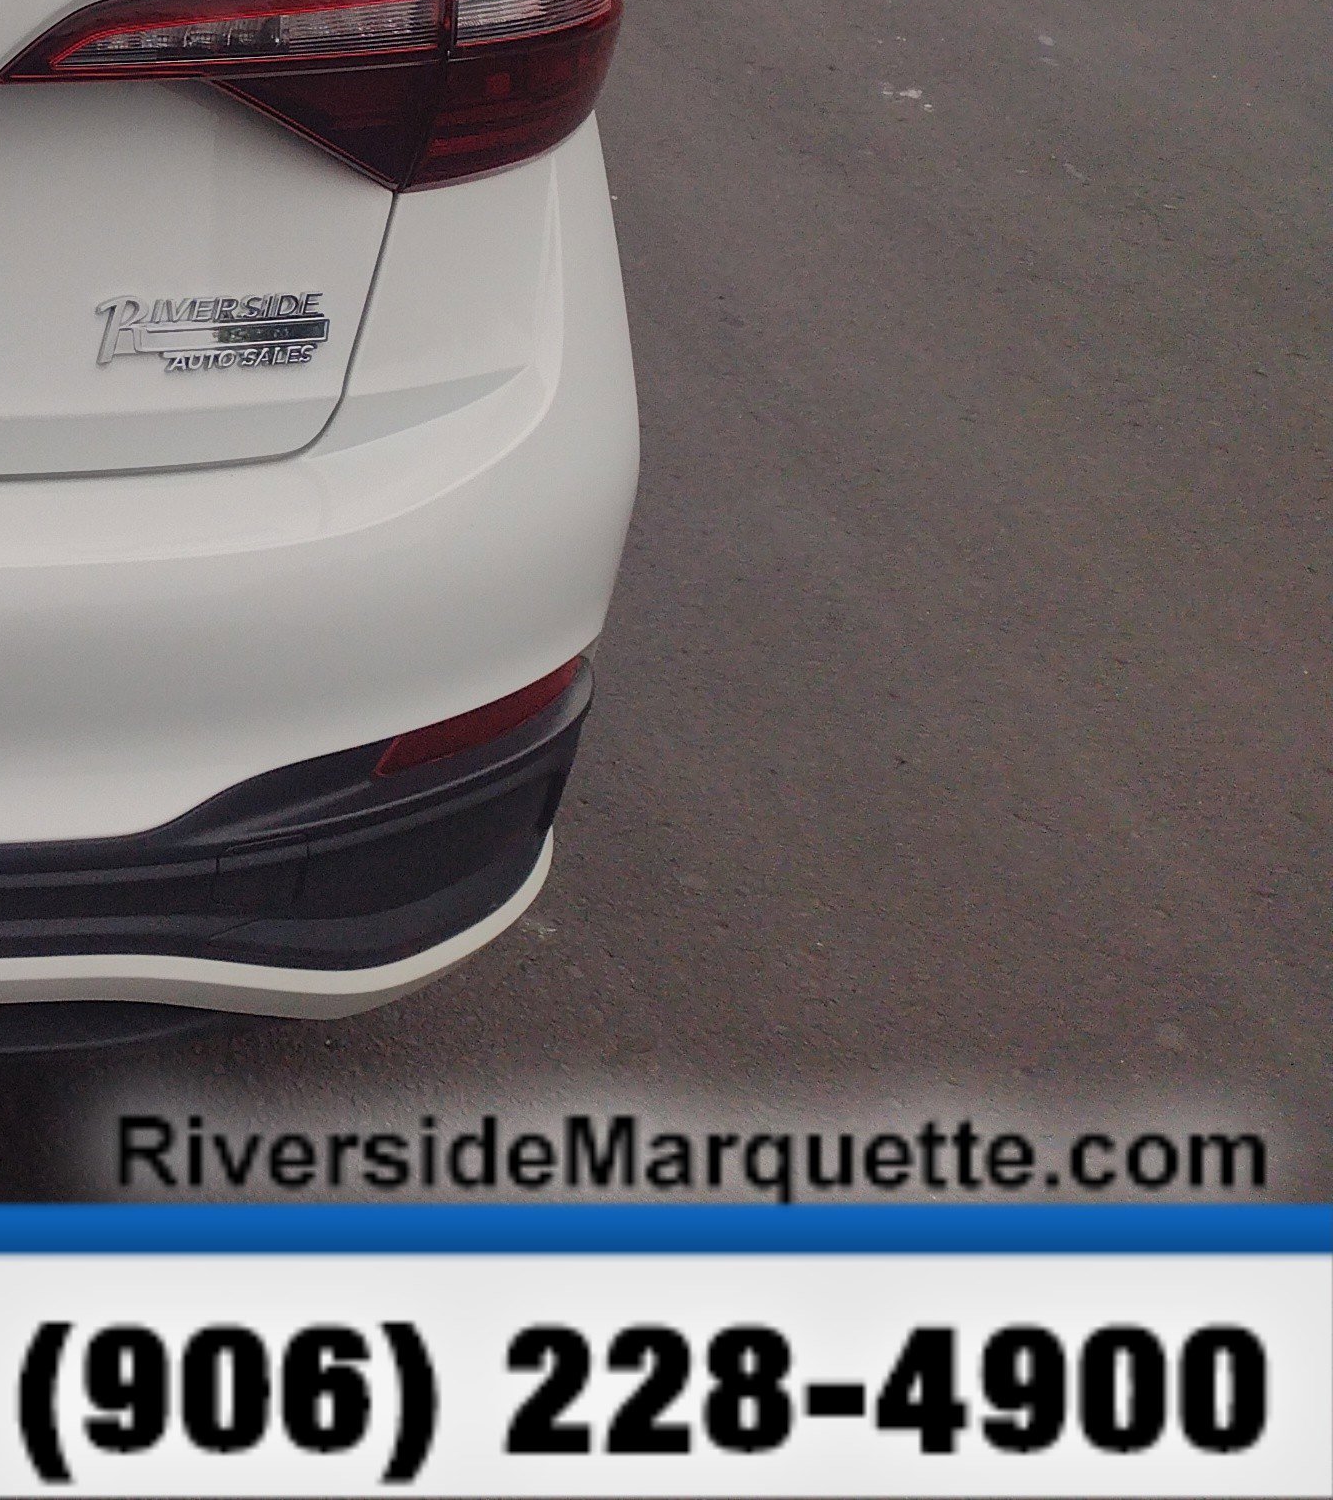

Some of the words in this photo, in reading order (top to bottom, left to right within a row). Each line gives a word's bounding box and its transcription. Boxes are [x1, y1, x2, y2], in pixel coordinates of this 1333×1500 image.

[95, 292, 324, 366] RIVERSIDE
[164, 350, 237, 371] AUTO
[241, 344, 316, 367] SALES
